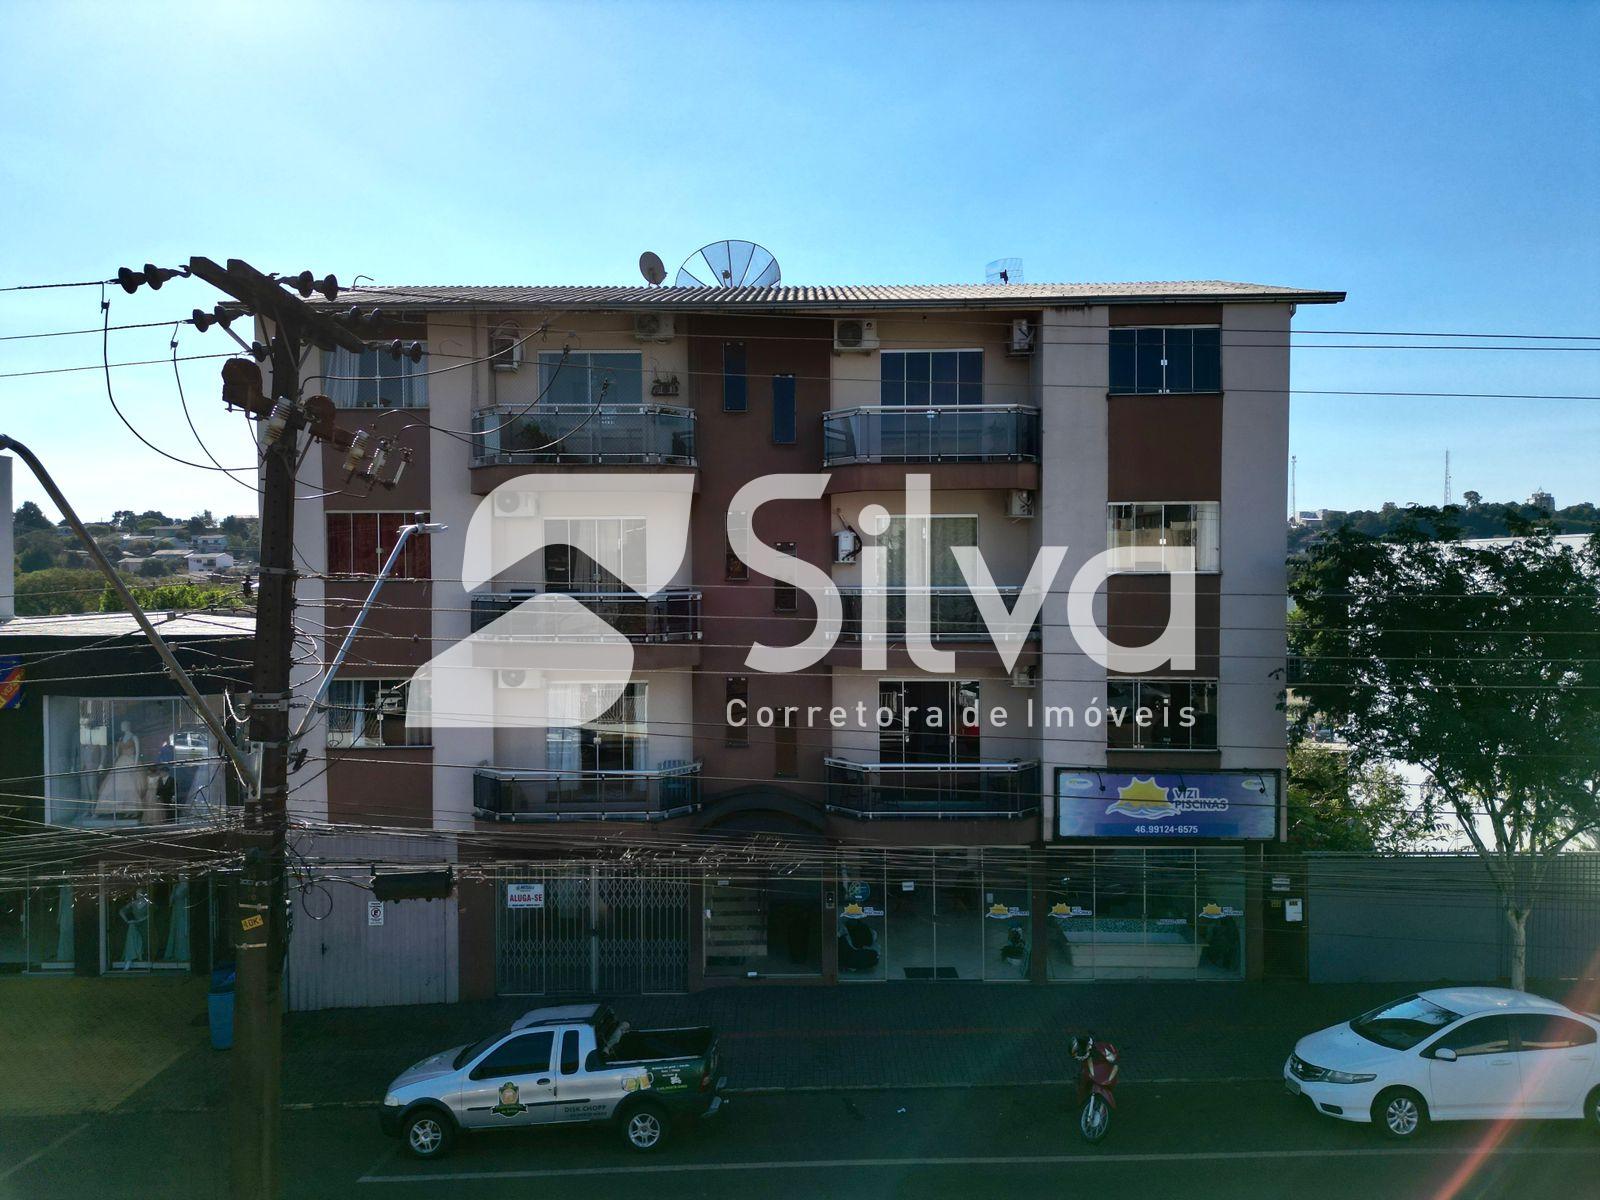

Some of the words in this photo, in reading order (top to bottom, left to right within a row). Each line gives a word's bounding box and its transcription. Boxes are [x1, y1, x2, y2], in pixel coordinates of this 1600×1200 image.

[1175, 799, 1227, 809] PISCINAS
[1135, 825, 1198, 834] 46.99124-6575
[510, 894, 543, 902] ALUGA-SE
